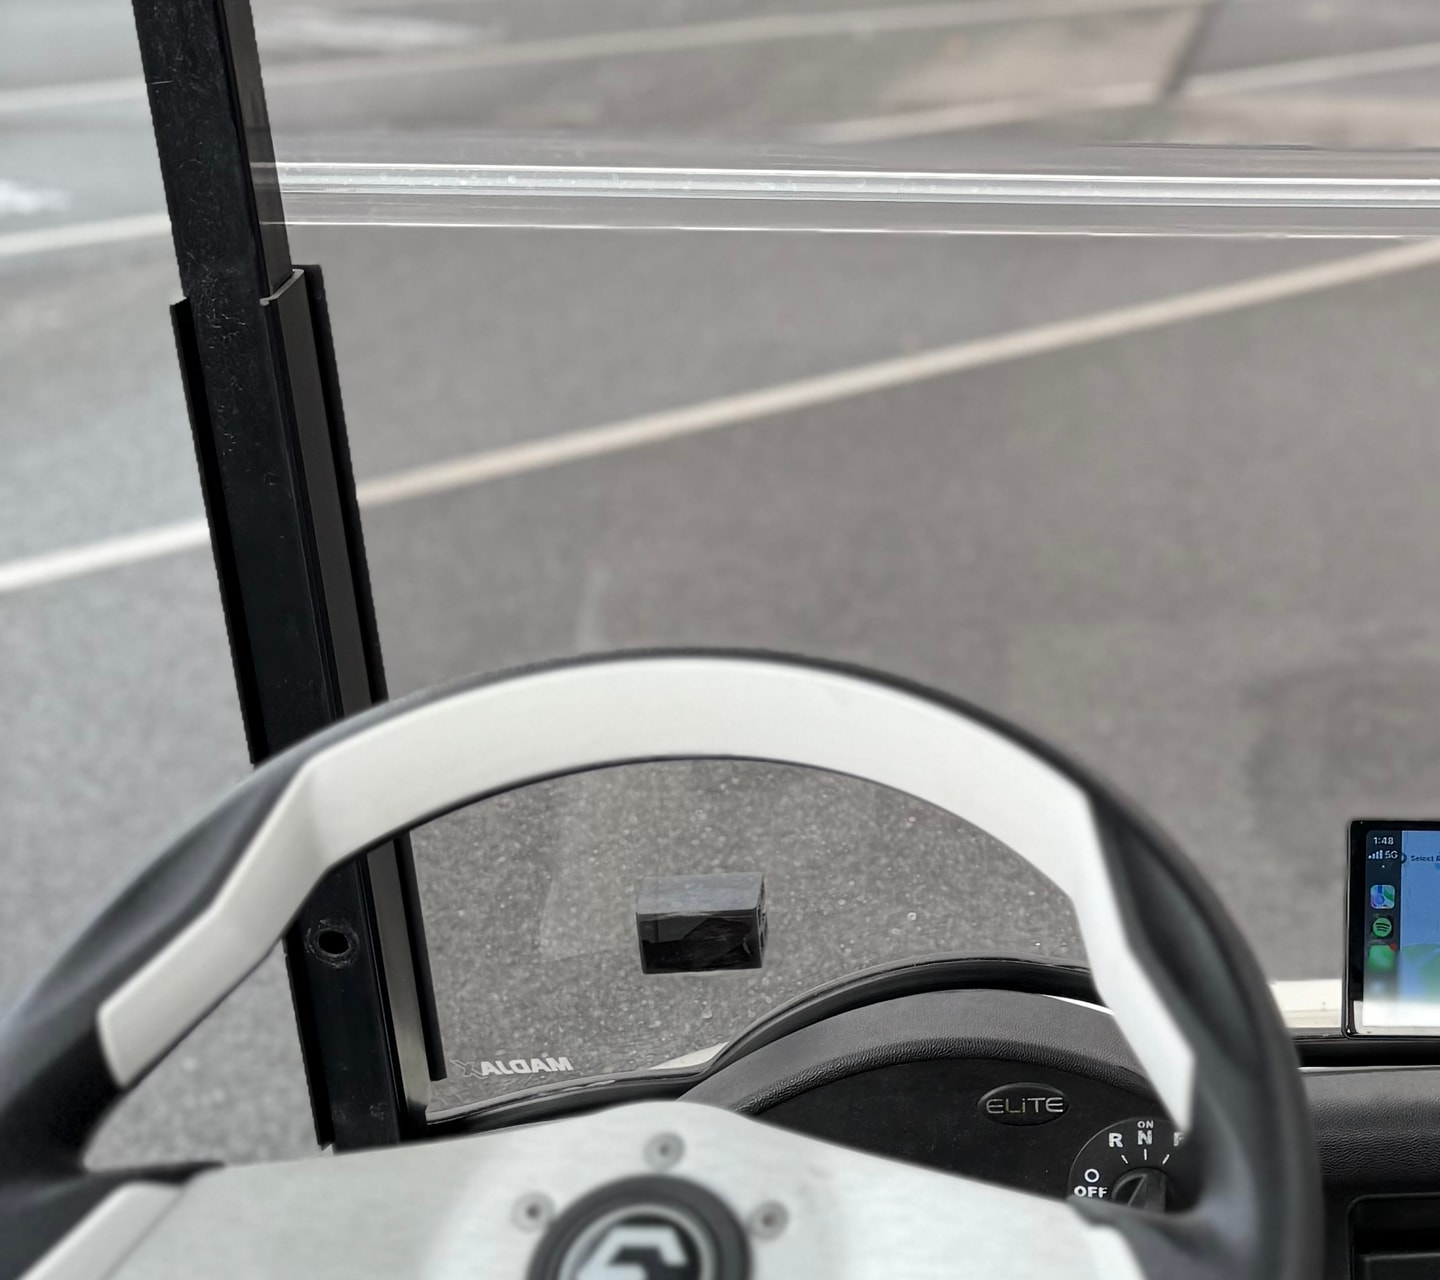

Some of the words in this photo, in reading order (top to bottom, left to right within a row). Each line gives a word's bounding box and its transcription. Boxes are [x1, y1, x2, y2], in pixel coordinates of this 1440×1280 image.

[1373, 837, 1394, 845] 1:48
[1384, 850, 1398, 859] 5G
[1137, 1120, 1154, 1129] ON
[1108, 1132, 1124, 1147] R
[1137, 1130, 1152, 1144] N
[1074, 1186, 1108, 1198] OFF
